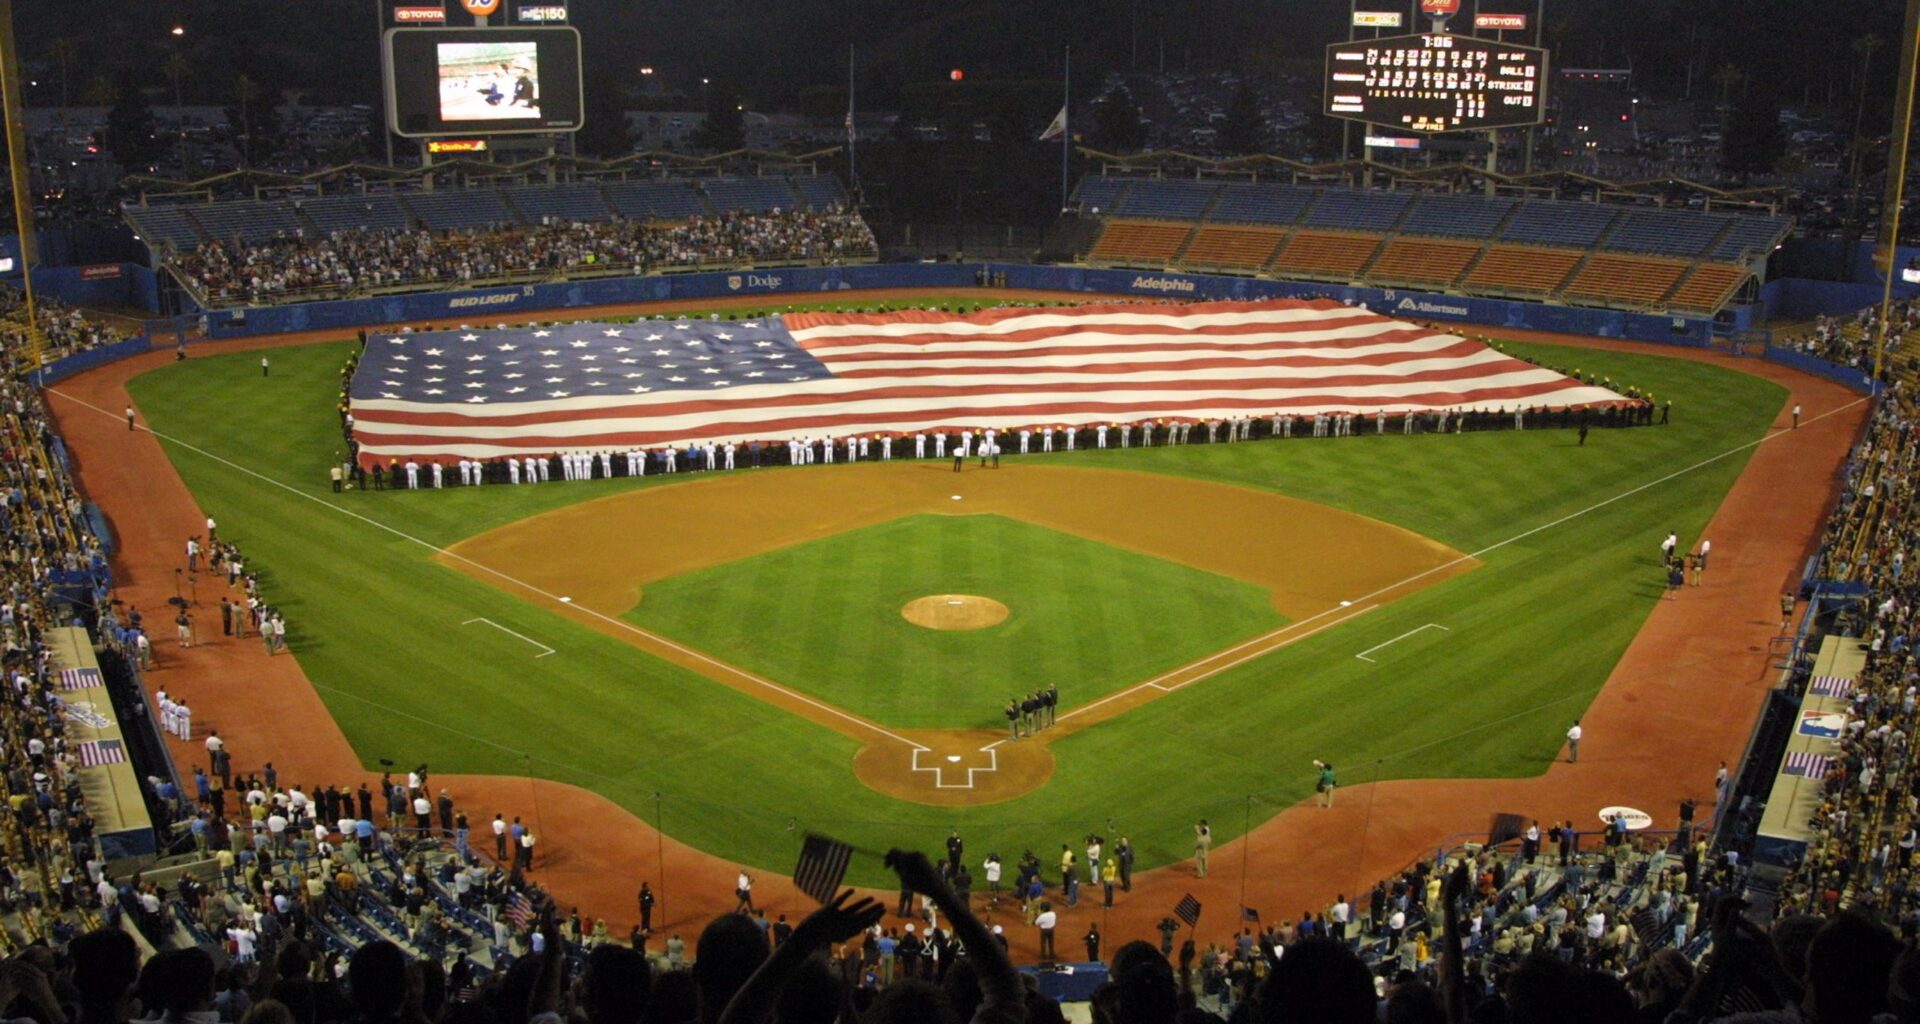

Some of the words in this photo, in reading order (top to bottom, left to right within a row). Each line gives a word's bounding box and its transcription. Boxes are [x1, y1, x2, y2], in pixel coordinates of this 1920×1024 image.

[410, 11, 444, 19] TOYOTA
[1421, 36, 1452, 48] 7:06
[1500, 66, 1524, 76] BALL
[1488, 81, 1524, 90] STRIKE
[1503, 95, 1522, 105] OUT
[748, 274, 782, 289] Dodge
[1132, 276, 1195, 292] Adelphia
[449, 297, 478, 308] BUD
[479, 293, 519, 304] LIGHT
[1417, 302, 1468, 315] Albertsons
